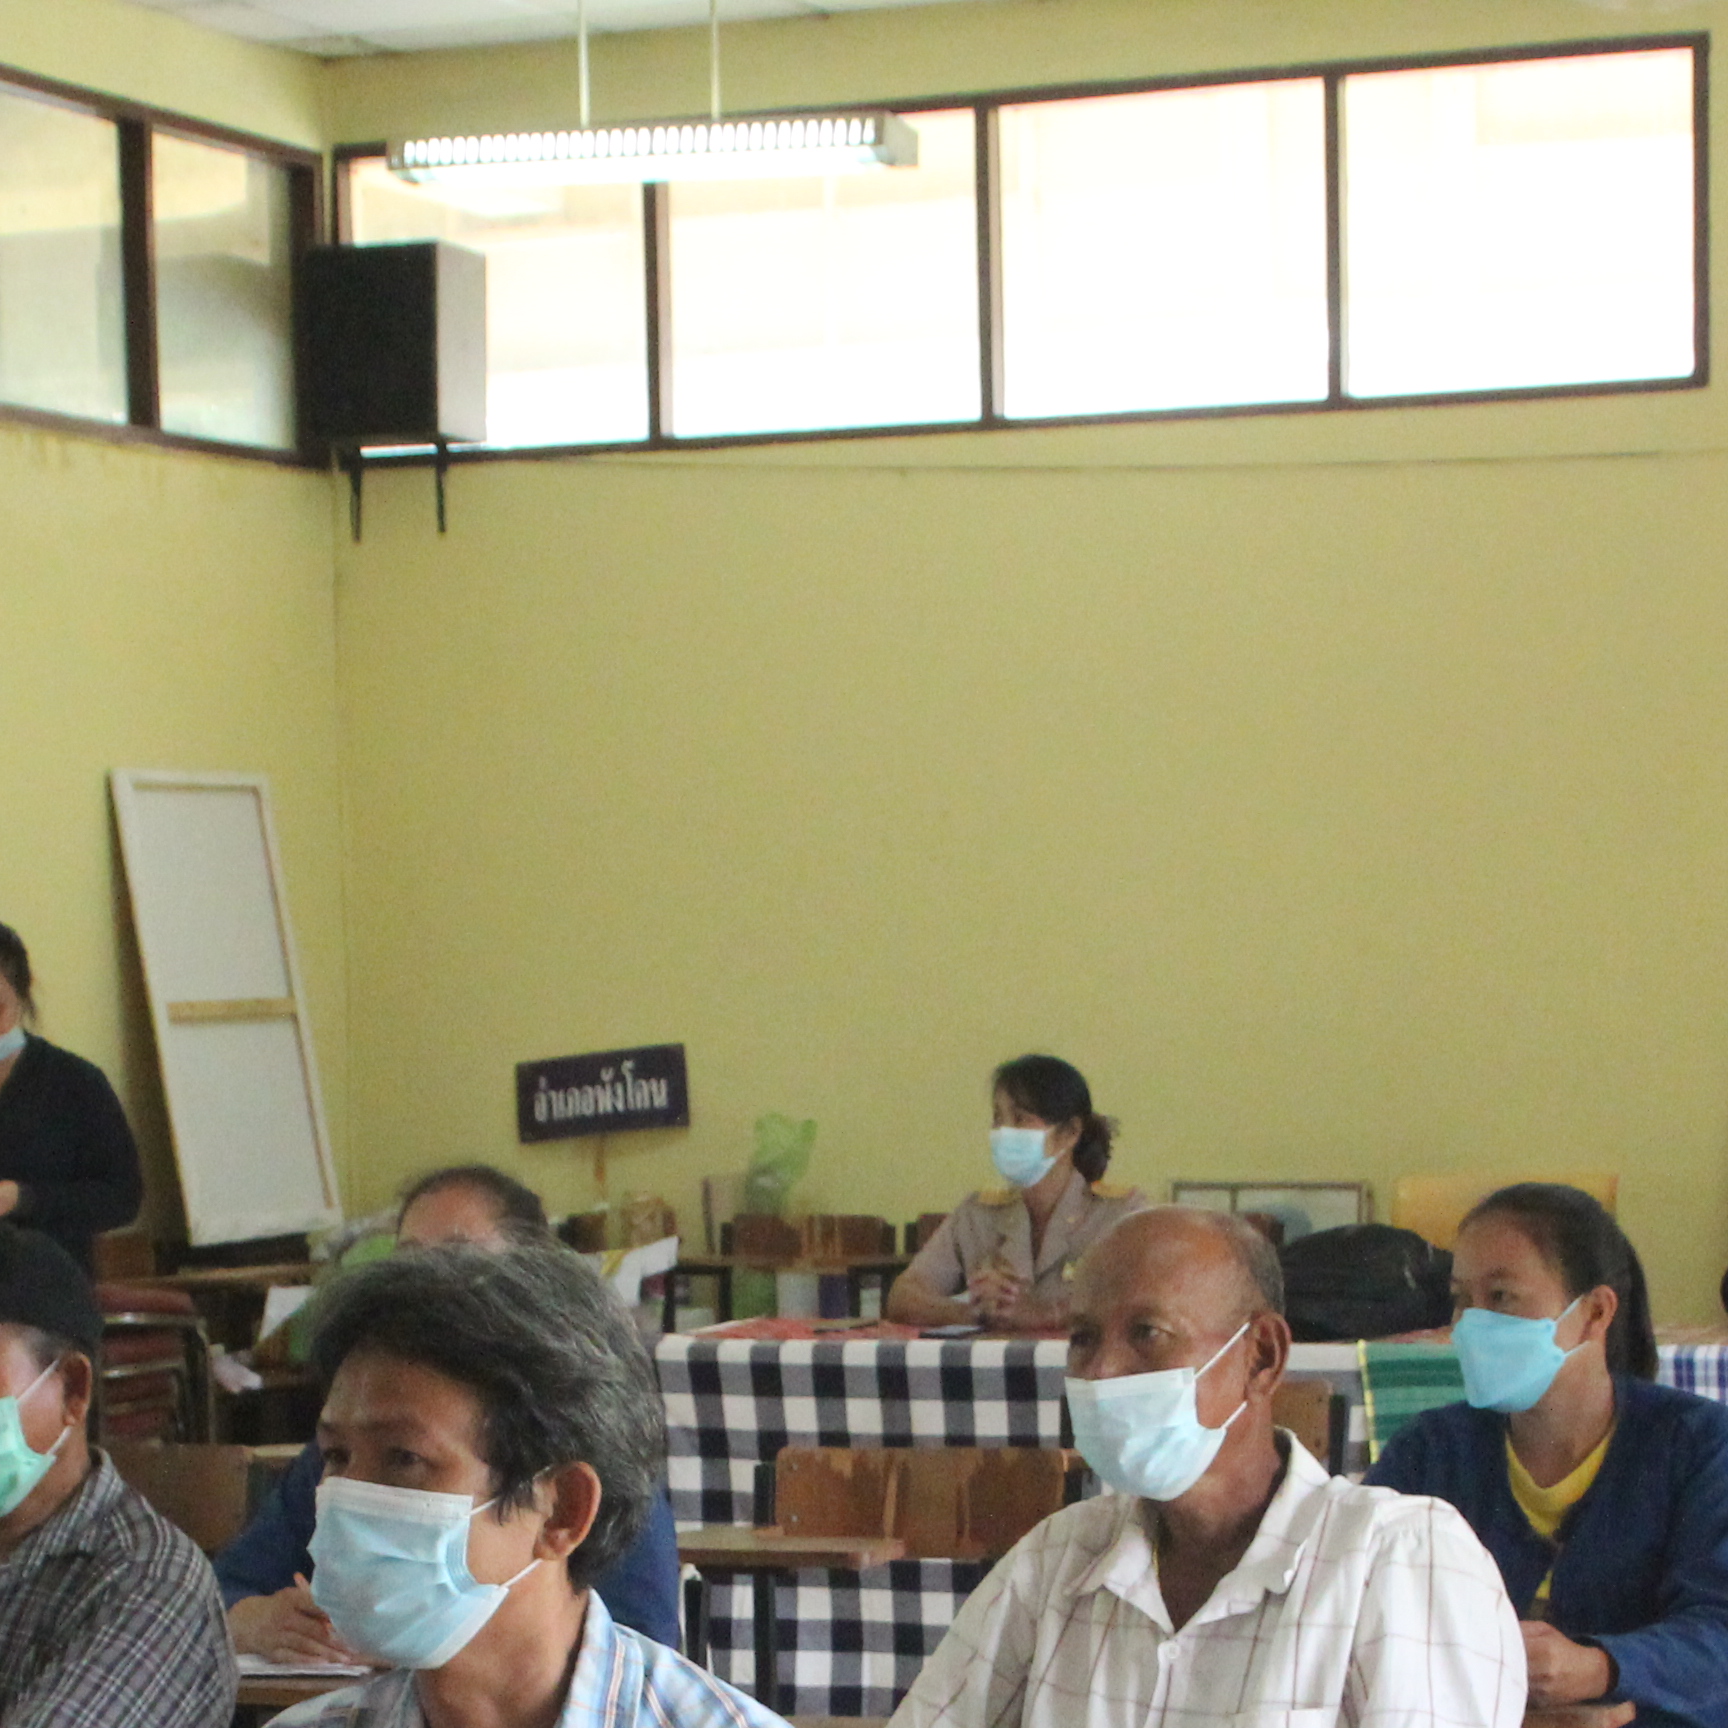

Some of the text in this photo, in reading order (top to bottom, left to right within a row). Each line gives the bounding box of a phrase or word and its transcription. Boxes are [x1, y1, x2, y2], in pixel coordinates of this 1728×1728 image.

[533, 1060, 669, 1124] อำเภอพังโคน
